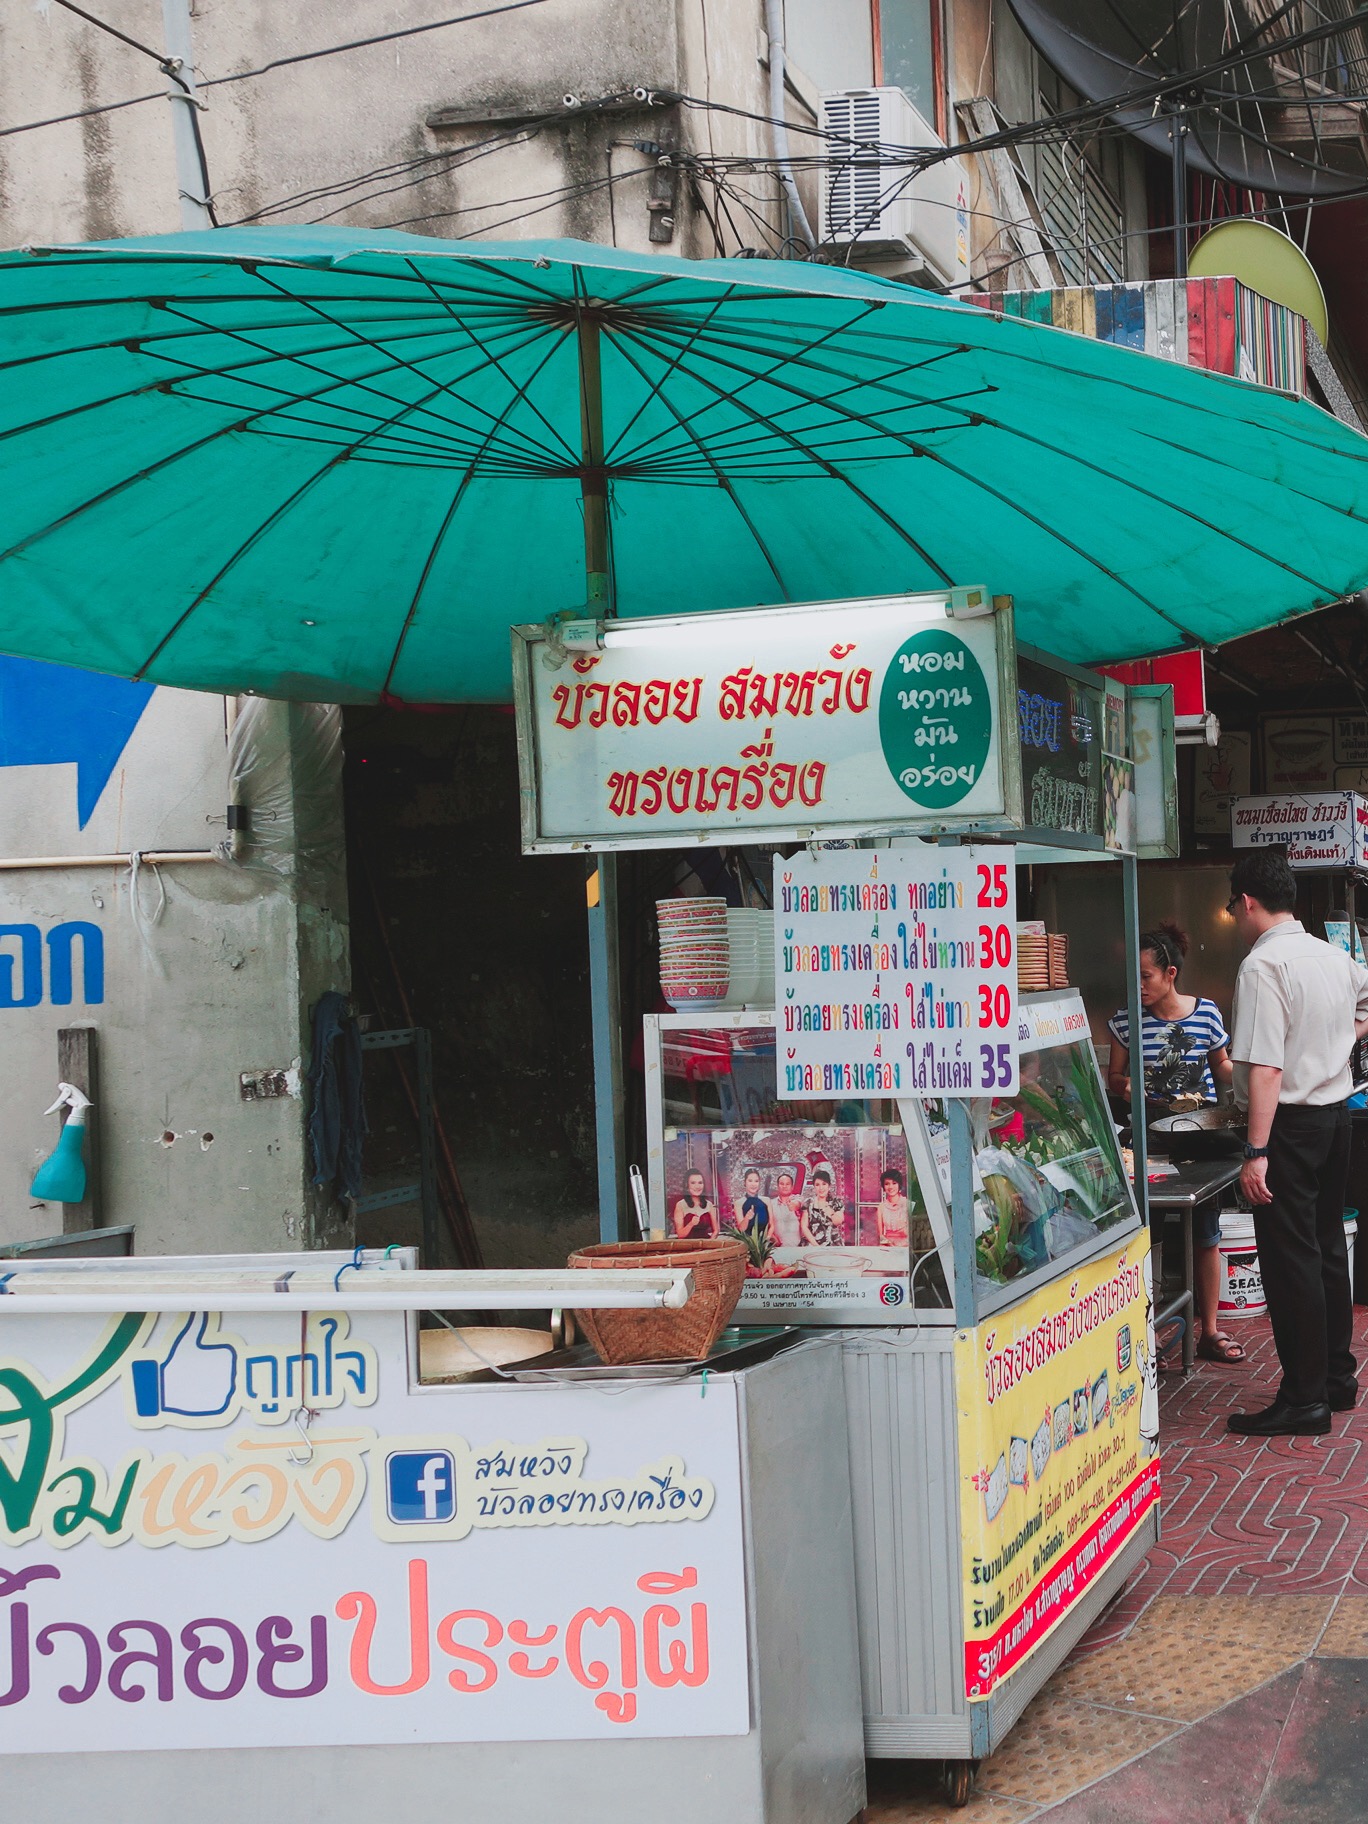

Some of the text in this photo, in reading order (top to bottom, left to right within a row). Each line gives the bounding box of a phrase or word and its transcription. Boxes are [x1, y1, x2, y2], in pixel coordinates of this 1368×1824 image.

[899, 650, 965, 674] หอม
[550, 643, 874, 731] บัวลอย สมหวัง
[897, 684, 973, 710] หวาน
[913, 717, 959, 747] มัน
[606, 727, 828, 818] ทรงเครื่อง
[899, 757, 976, 788] อร่อย
[1236, 800, 1308, 825] ขนมเบื้องไทย
[1250, 825, 1336, 844] สำราญราษฎร์
[782, 855, 897, 913] บัวลอยทรงเครื่อง
[977, 864, 1008, 908] 25
[978, 924, 1012, 969] 30
[784, 974, 899, 1031] บัวลอยทรงเครื่อง
[977, 984, 1011, 1028] 30
[786, 1034, 1012, 1091] บัวลอยทรงเครื่อง ใส่ไข่เค็ม 35
[985, 1251, 1140, 1404] บัวลอยสมหวังทรงเครื่อง
[245, 1317, 368, 1413] ถูกใจ
[475, 1447, 577, 1480] สมหวัง
[477, 1466, 704, 1516] บัวลอยทรงเครื่อง
